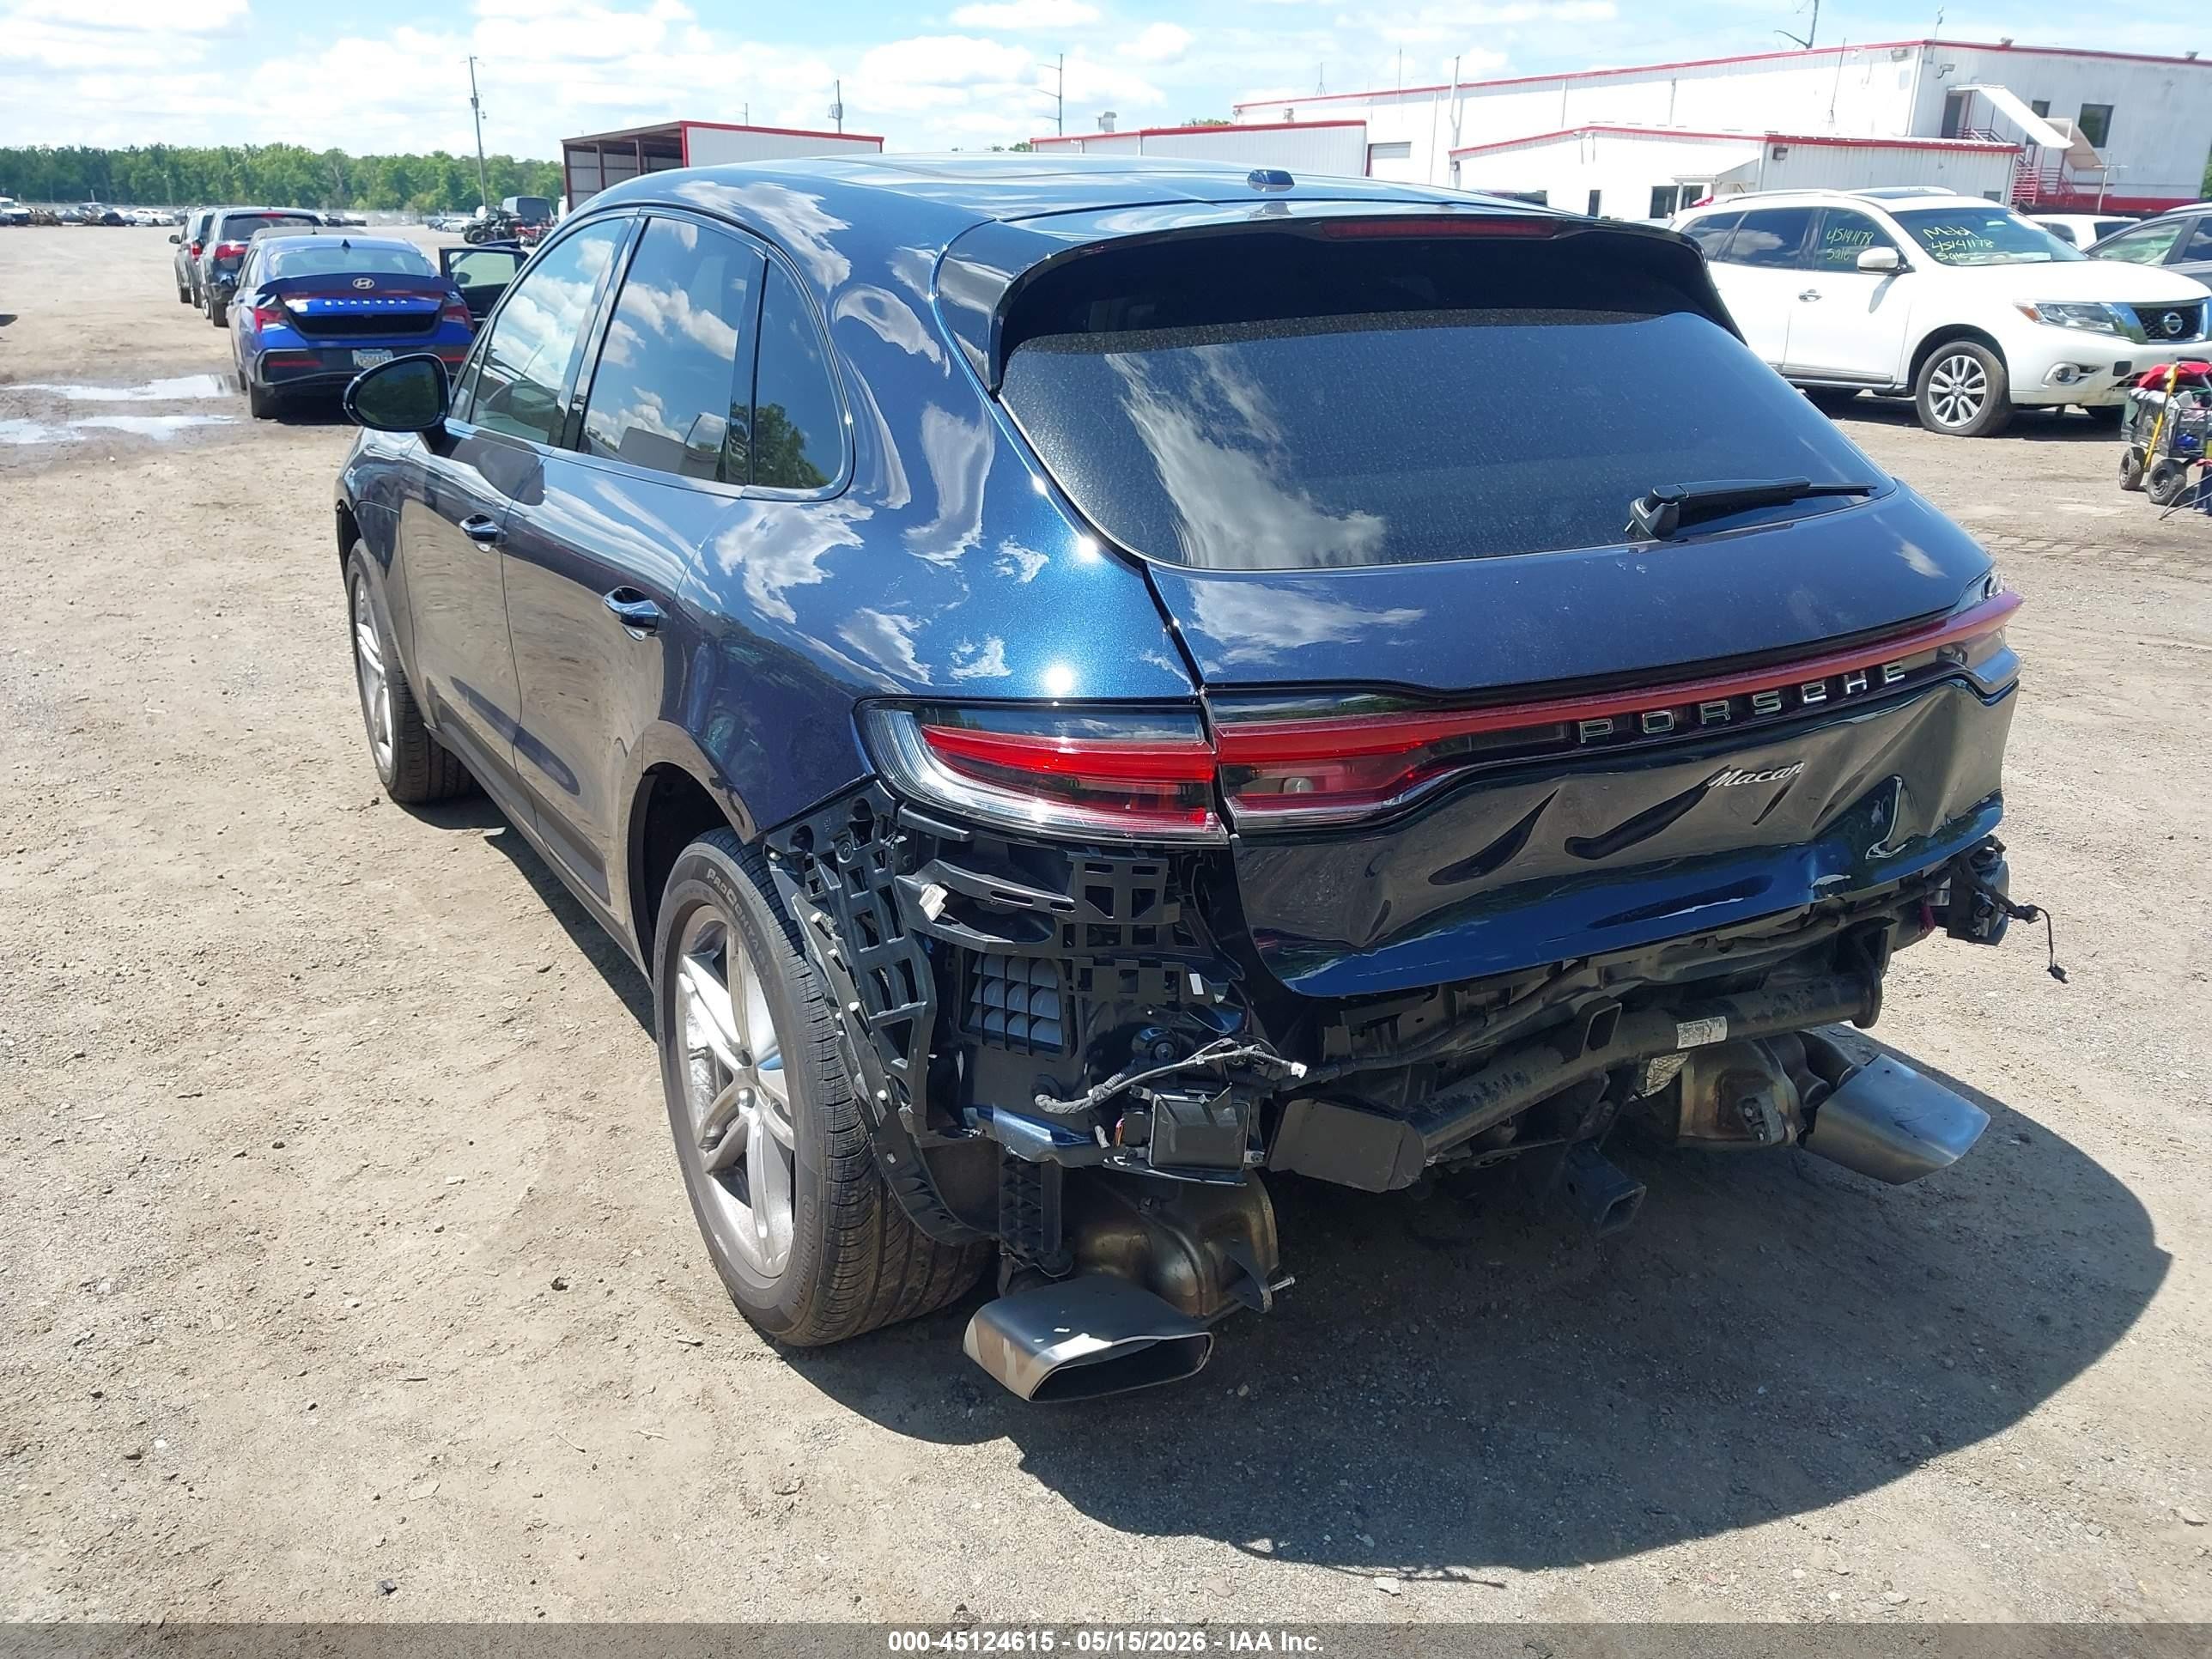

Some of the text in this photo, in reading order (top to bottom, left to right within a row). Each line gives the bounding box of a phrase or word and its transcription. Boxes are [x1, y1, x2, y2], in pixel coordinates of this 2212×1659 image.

[1932, 239, 1994, 252] 45141178
[1579, 660, 1905, 744] PORSCHE
[1708, 762, 1805, 788] Macan
